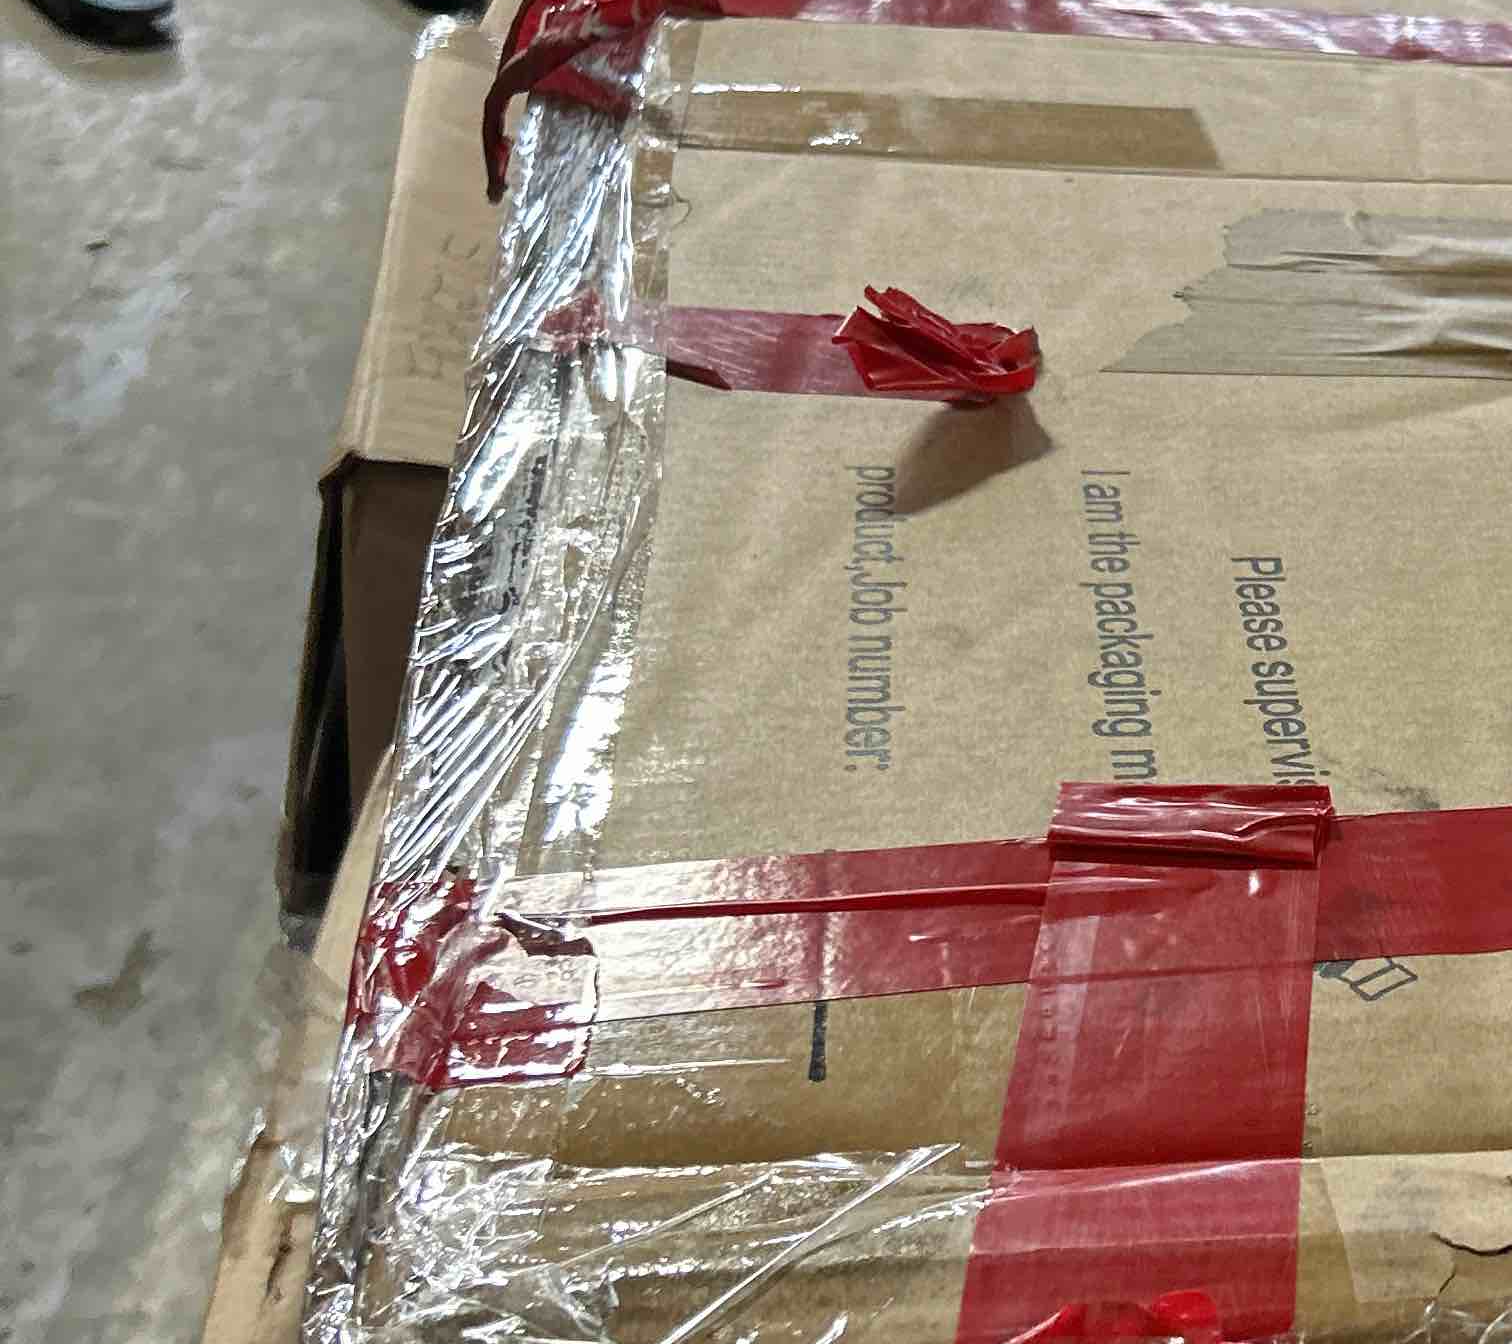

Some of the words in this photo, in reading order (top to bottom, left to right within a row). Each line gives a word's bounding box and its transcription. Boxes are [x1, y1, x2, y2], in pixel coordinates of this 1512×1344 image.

[1083, 483, 1123, 523] am
[1089, 533, 1141, 574] the
[1231, 556, 1288, 653] Please
[844, 635, 907, 774] number:
[1080, 582, 1163, 738] packaging
